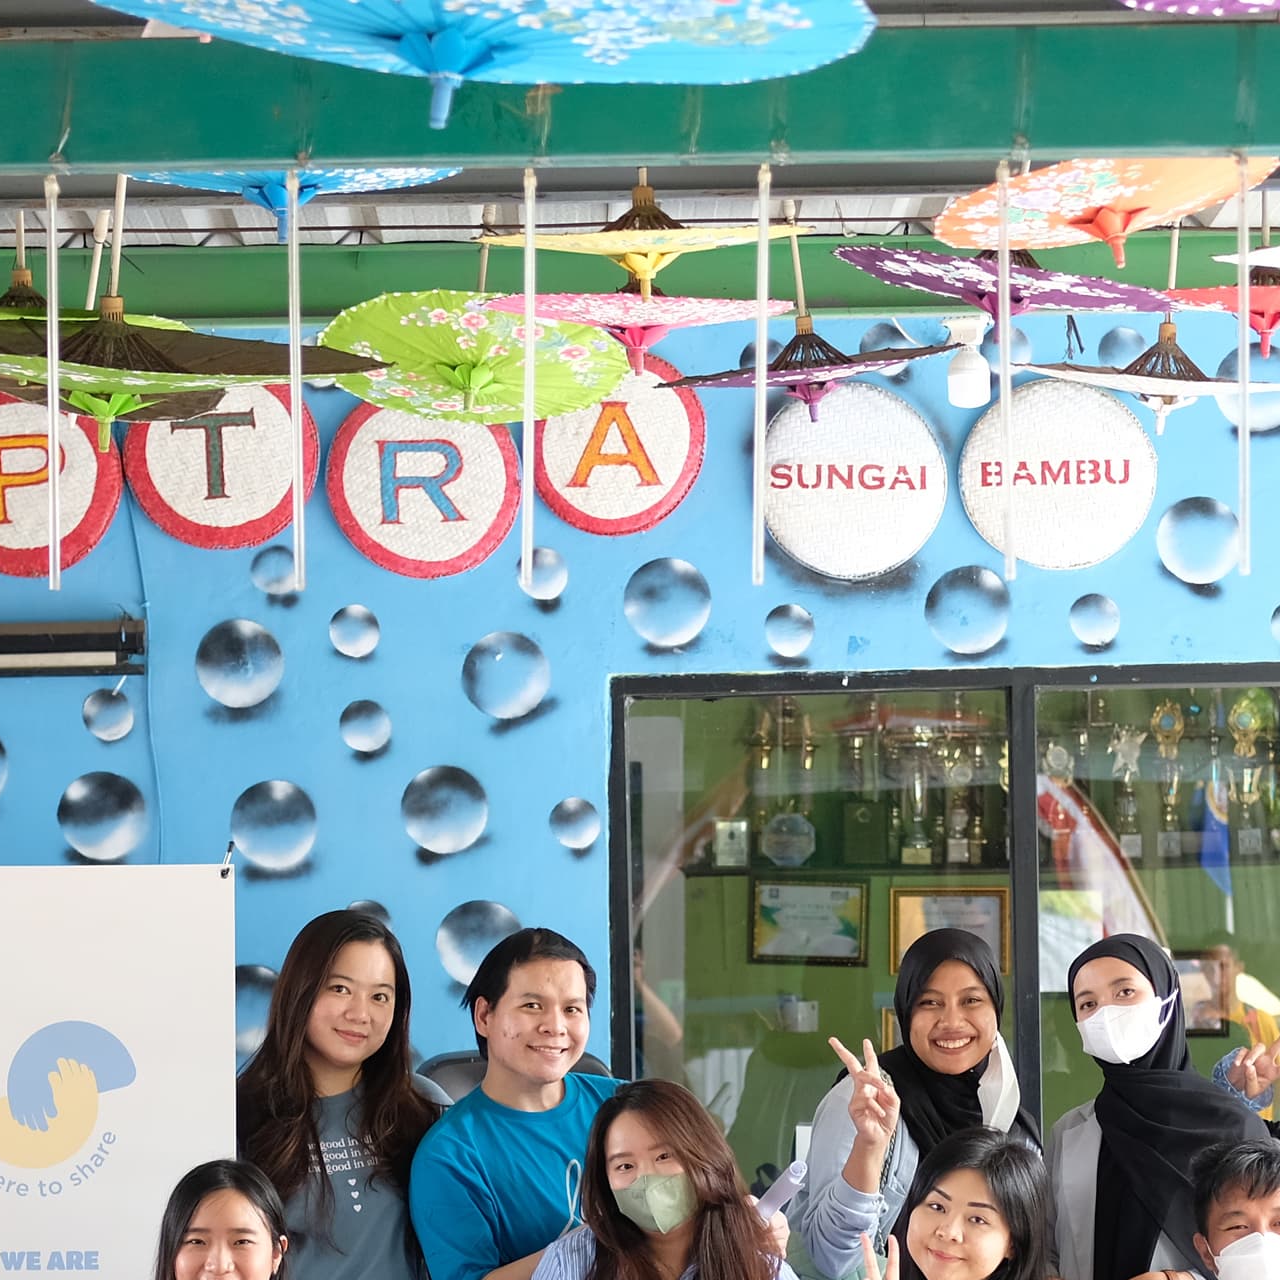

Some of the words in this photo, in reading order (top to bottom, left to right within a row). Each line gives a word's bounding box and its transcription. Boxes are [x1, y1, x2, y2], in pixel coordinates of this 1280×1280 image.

[769, 462, 928, 492] SUNGAI
[979, 458, 1132, 488] BAMBU
[320, 1138, 346, 1152] good
[348, 1137, 359, 1147] in
[38, 1180, 64, 1198] to
[69, 1129, 118, 1186] share
[322, 1149, 349, 1164] good
[351, 1148, 362, 1158] in
[325, 1161, 352, 1175] good
[353, 1159, 365, 1169] in
[0, 1251, 41, 1271] WE
[46, 1251, 100, 1271] ARE
